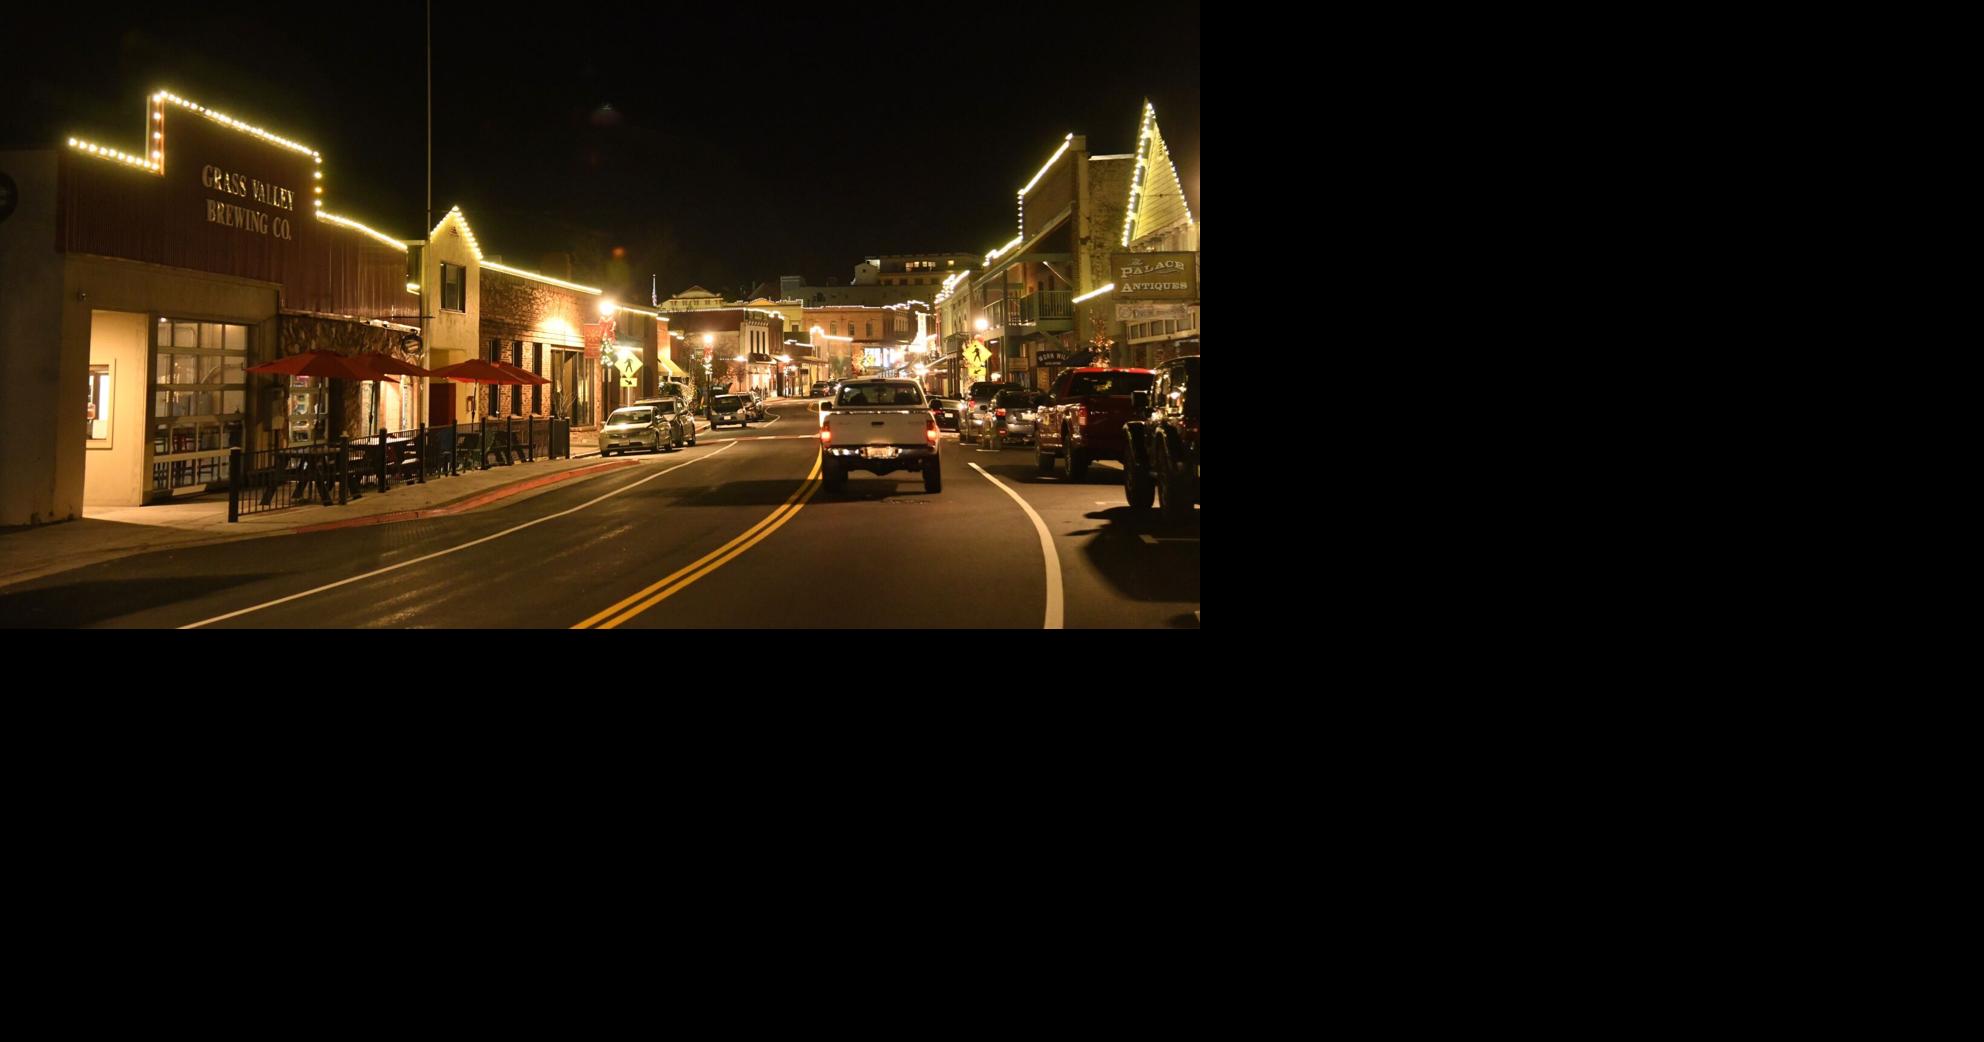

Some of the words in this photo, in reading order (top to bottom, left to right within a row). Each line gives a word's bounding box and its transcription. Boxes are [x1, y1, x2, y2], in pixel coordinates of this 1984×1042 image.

[201, 164, 247, 197] GRASS
[250, 178, 295, 211] VALLEY
[206, 198, 269, 234] BREWING
[272, 216, 292, 241] CO.
[1120, 260, 1185, 278] PALACE
[1120, 282, 1188, 293] ANTIQUES
